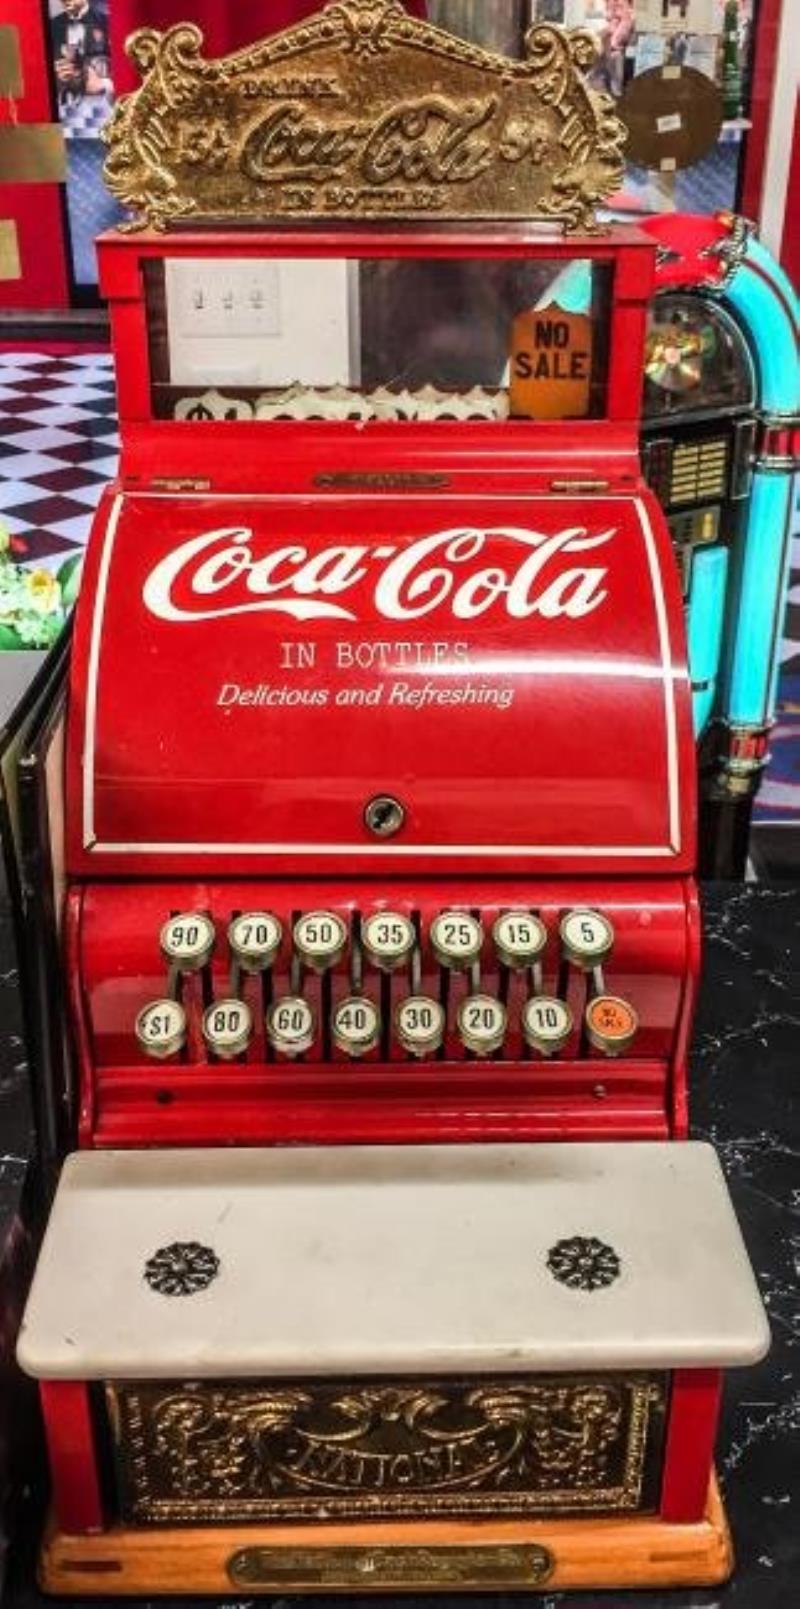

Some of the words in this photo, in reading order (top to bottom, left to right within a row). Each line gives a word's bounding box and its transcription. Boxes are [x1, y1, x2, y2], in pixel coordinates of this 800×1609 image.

[239, 99, 497, 183] Coca-Cola
[534, 320, 570, 348] NO
[514, 352, 588, 379] SALE
[142, 526, 617, 621] Coca-Cola
[279, 642, 317, 669] IN
[336, 641, 471, 670] BOTTLES
[217, 683, 328, 706] Delicious
[335, 683, 384, 705] and
[388, 682, 515, 709] Refreshing
[171, 926, 198, 947] 90
[241, 924, 268, 945] 70
[305, 924, 333, 943] 50
[377, 923, 404, 945] 35
[443, 924, 471, 946] 25
[508, 924, 531, 943] 15
[580, 921, 595, 943] 5
[149, 1014, 170, 1036] $1
[213, 1010, 241, 1032] 80
[278, 1009, 304, 1031] 60
[338, 1008, 367, 1030] 40
[405, 1008, 432, 1030] 30
[468, 1008, 495, 1030] 20
[536, 1007, 558, 1029] 10
